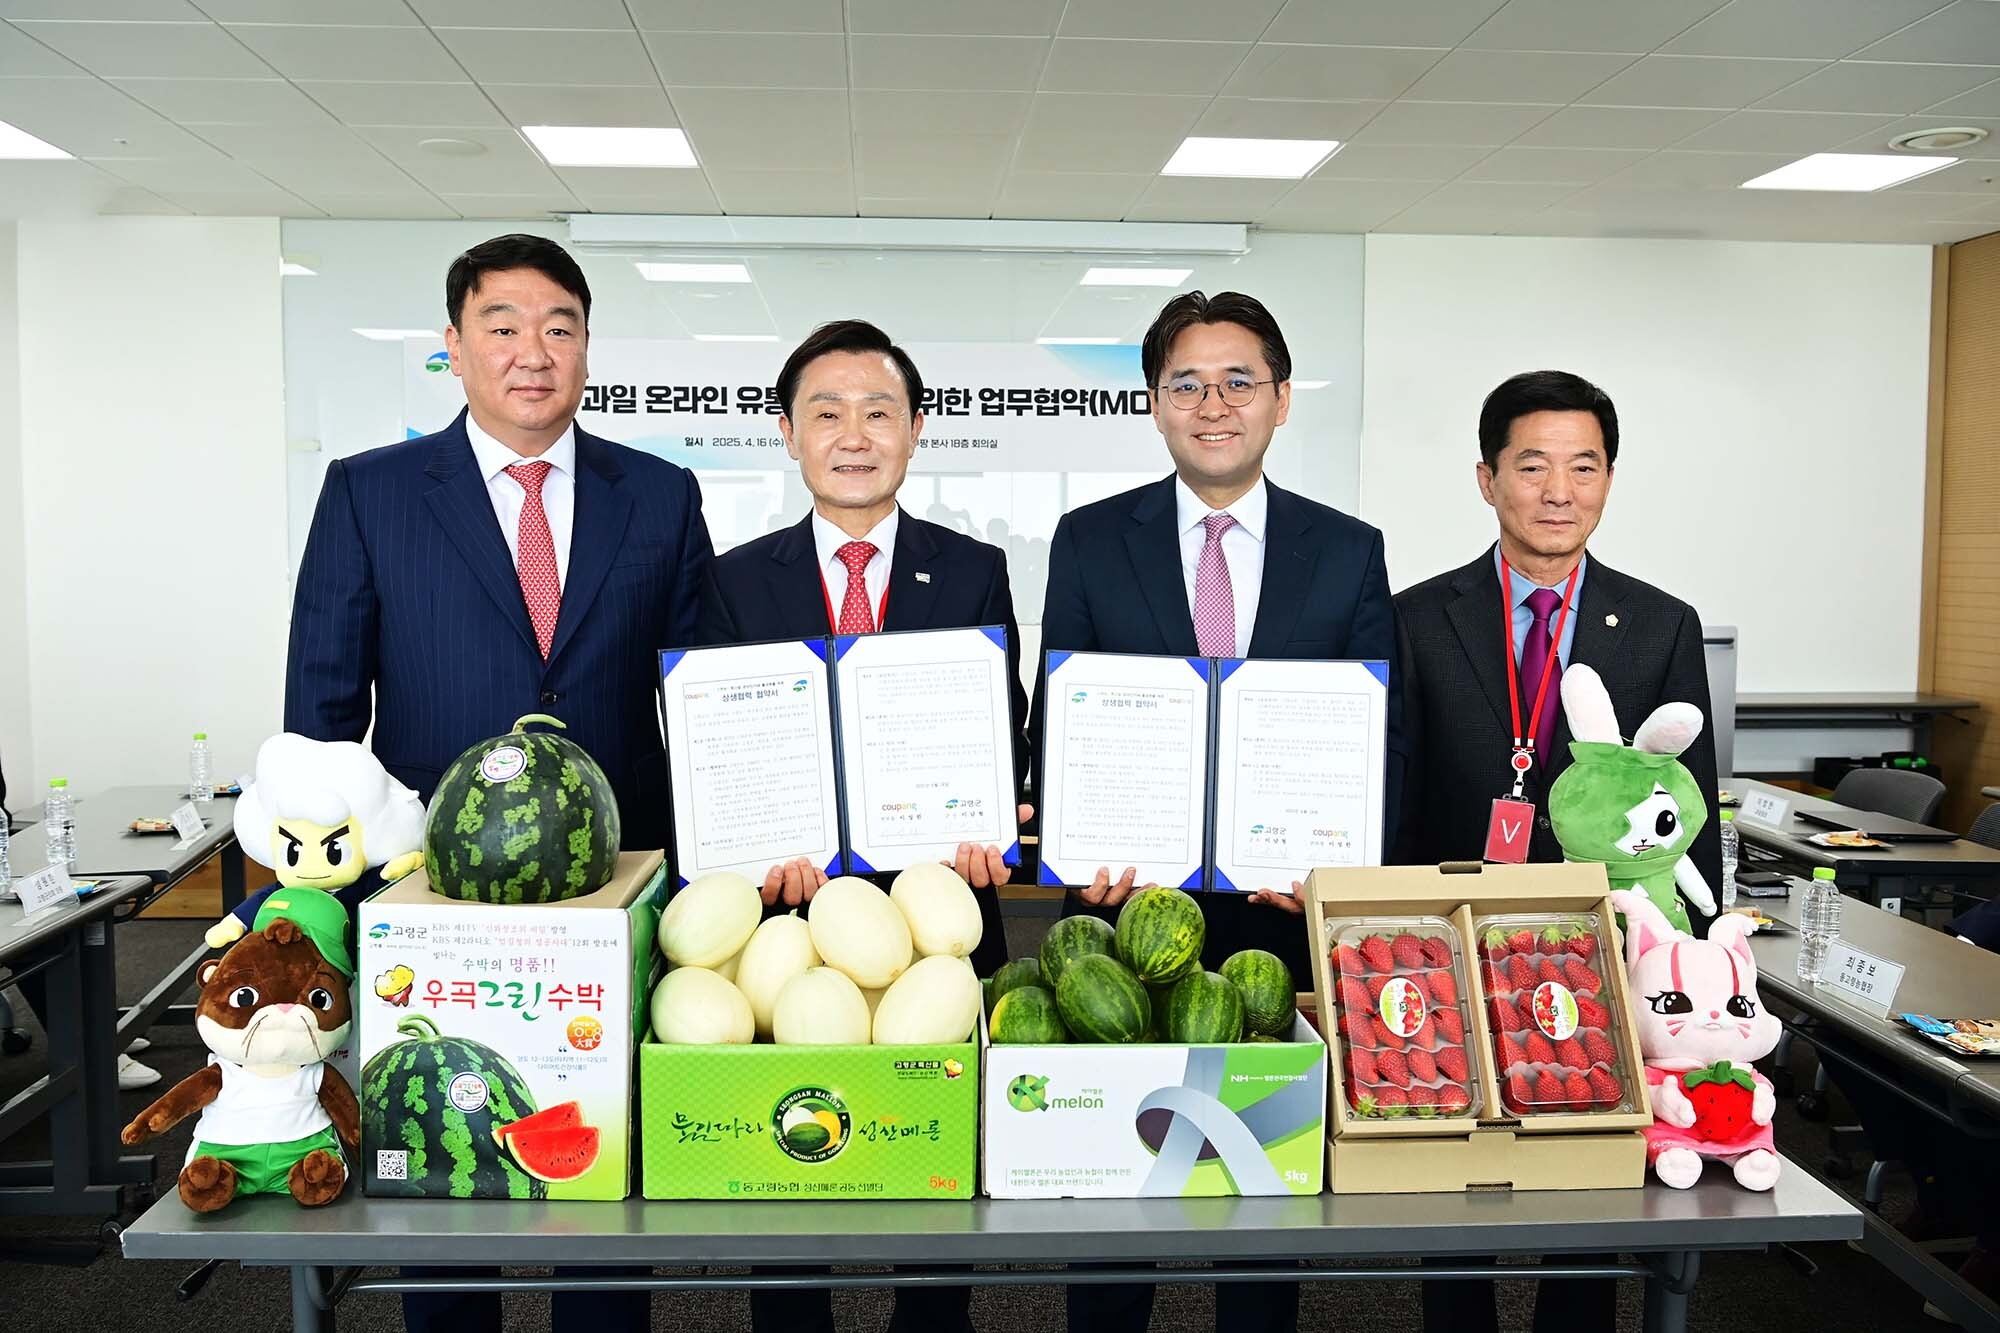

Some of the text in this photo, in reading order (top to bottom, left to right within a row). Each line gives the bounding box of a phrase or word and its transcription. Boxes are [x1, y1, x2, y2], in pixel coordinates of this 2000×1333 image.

[581, 384, 637, 414] 과일
[645, 385, 728, 414] 온라인
[685, 437, 703, 447] 일시
[917, 439, 998, 449] 팡 본사 18층 회의실
[756, 689, 779, 699] 협약서
[1501, 818, 1522, 844] V
[391, 926, 427, 940] 고령군
[432, 936, 450, 945] KBS
[462, 957, 555, 973] 수박의 명품!!
[1230, 1074, 1249, 1082] NH
[778, 1090, 842, 1112] SEONGSAN MALLON
[1051, 1095, 1104, 1109] melon
[789, 1150, 817, 1161] PRODUCT
[929, 1176, 958, 1191] 5kg
[1285, 1169, 1309, 1185] 5kg
[743, 1181, 800, 1193] 동고령농협
